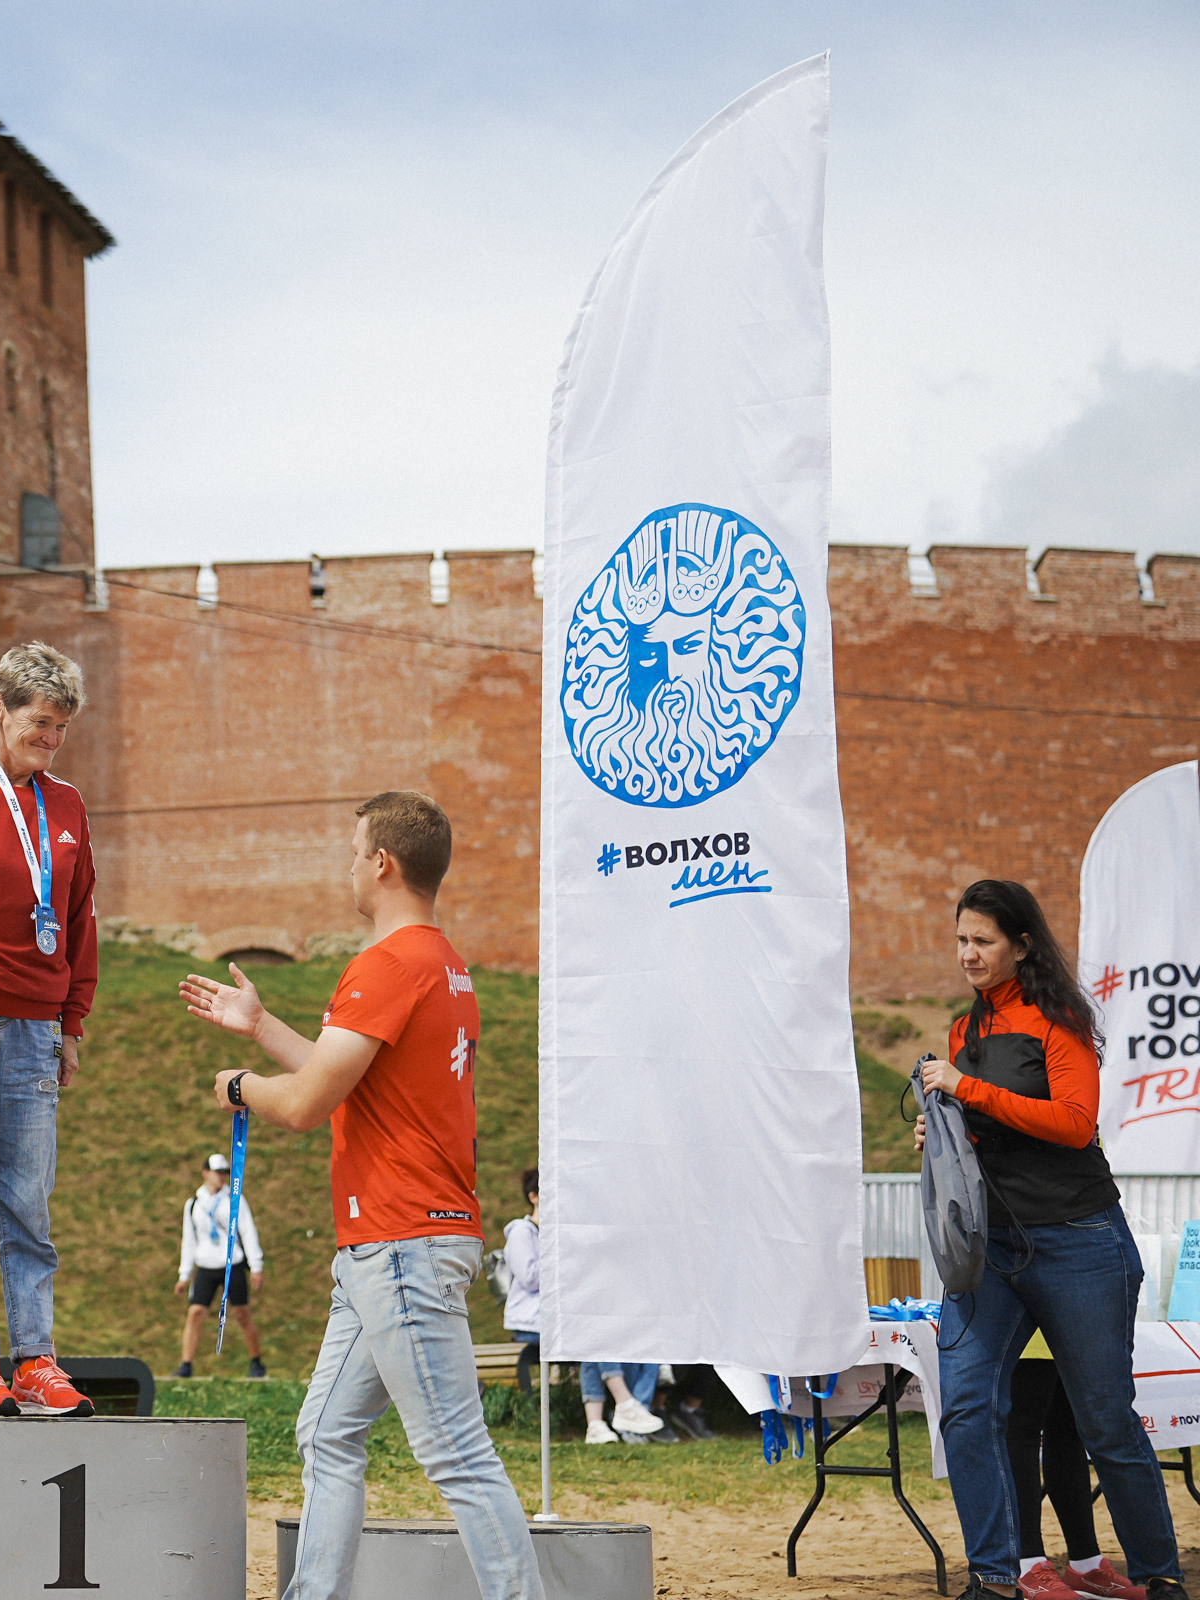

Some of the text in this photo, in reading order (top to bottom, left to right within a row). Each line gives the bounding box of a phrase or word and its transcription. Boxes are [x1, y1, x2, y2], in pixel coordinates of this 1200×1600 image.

[597, 832, 751, 877] #ВОЛХОВ
[671, 860, 769, 891] мен
[1147, 993, 1200, 1030] go
[1140, 1415, 1155, 1429] RI
[41, 1463, 100, 1589] 1
